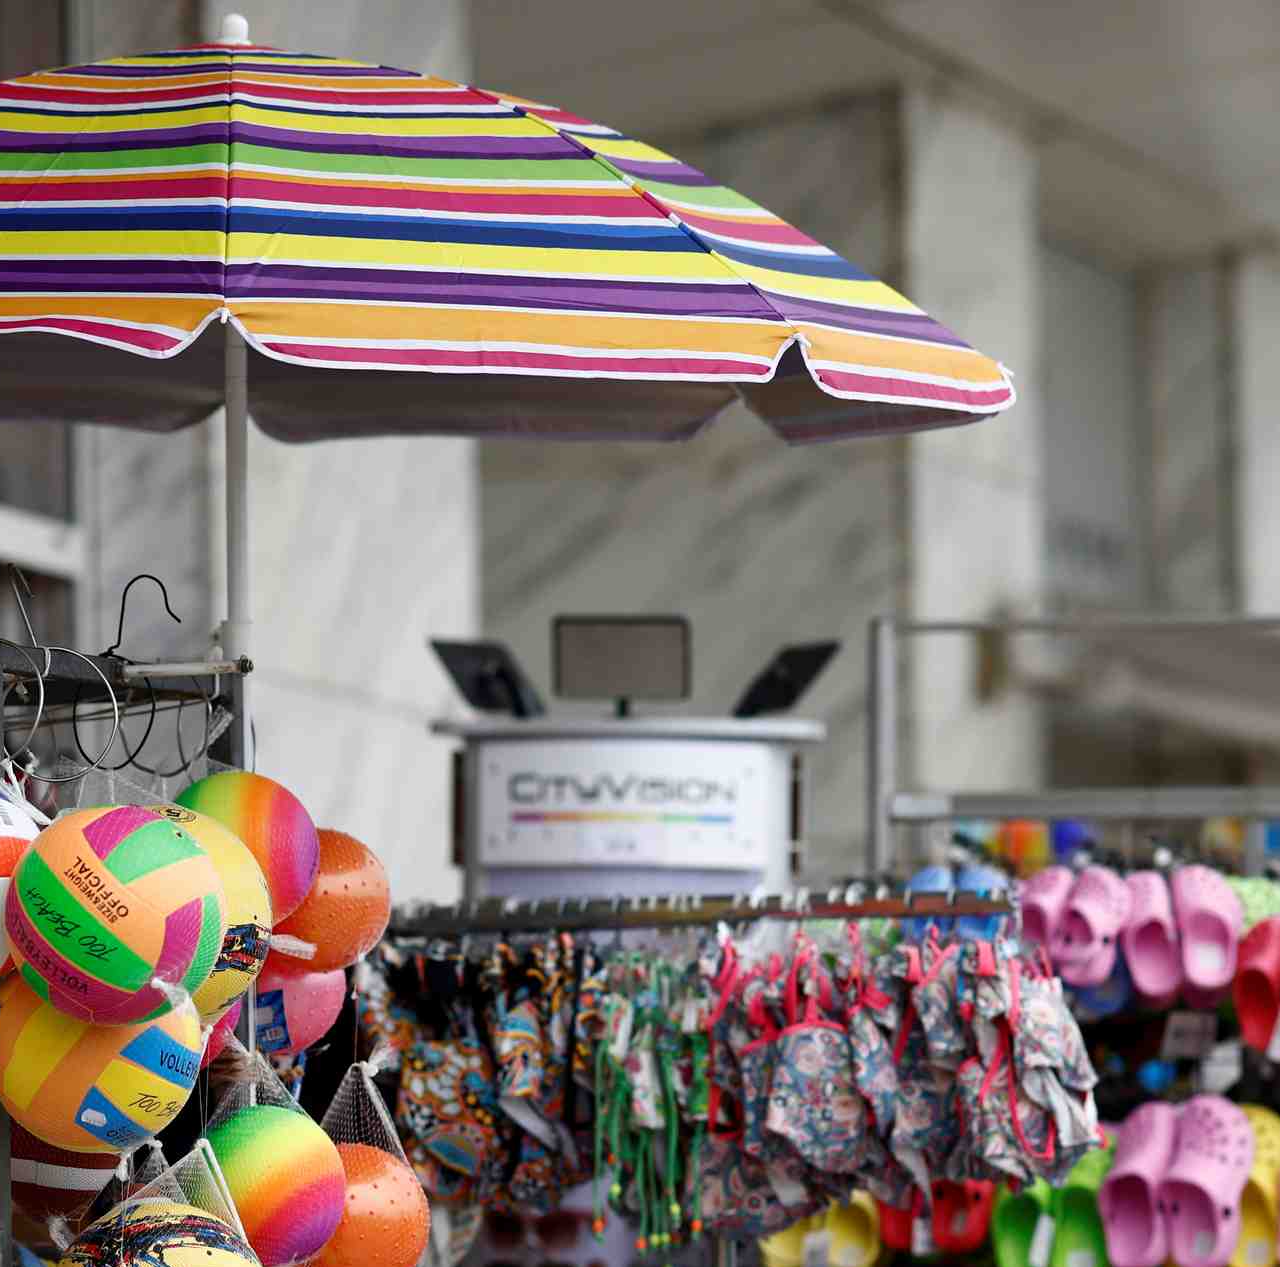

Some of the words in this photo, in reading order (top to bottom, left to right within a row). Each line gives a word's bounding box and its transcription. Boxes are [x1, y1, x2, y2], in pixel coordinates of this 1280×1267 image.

[71, 855, 129, 918] OFFICIAL
[25, 887, 81, 938] BEACH
[78, 935, 119, 962] TOO
